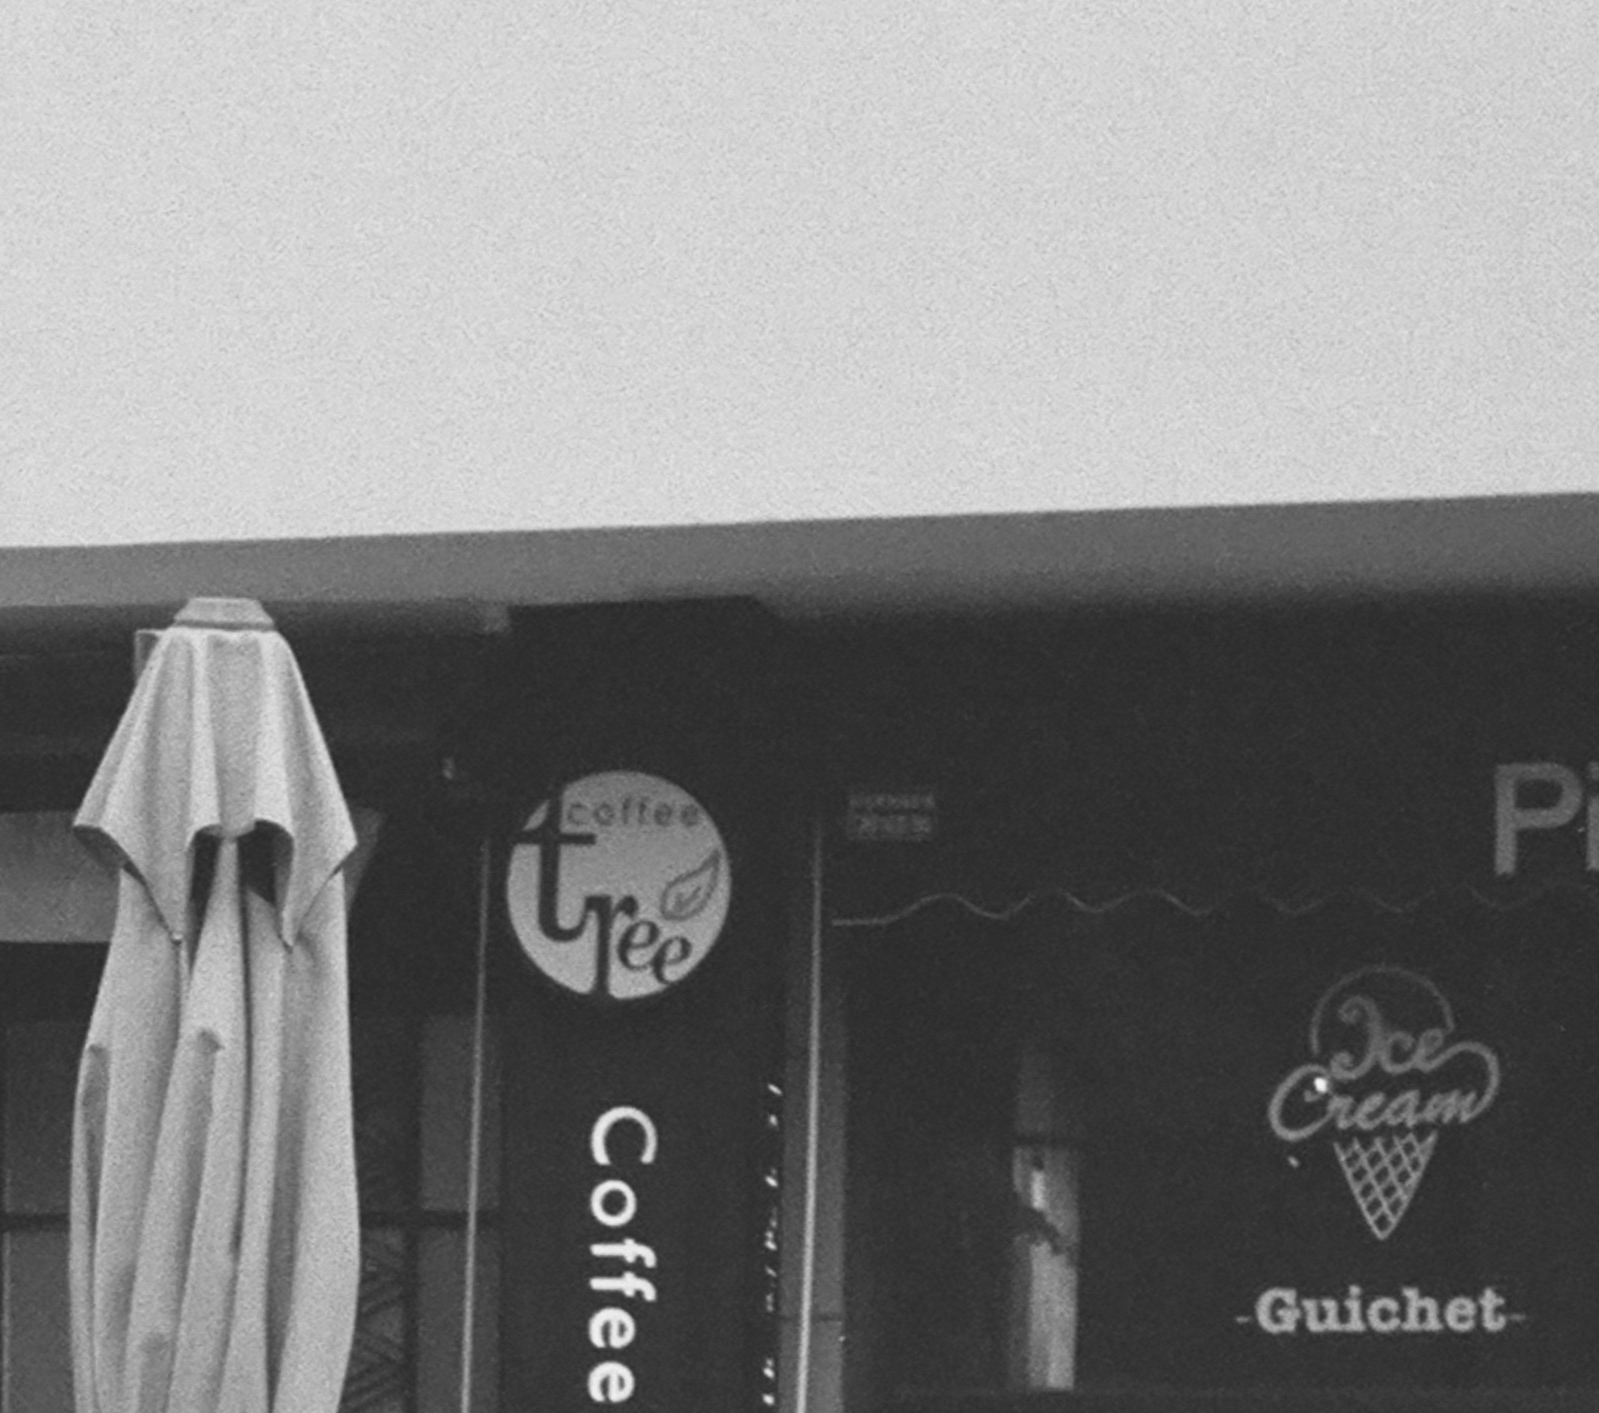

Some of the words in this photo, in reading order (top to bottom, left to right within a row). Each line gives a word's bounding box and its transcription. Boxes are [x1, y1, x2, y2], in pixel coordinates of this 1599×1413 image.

[565, 799, 703, 832] coffee
[1328, 994, 1448, 1082] Ice
[1268, 1062, 1502, 1142] Cream
